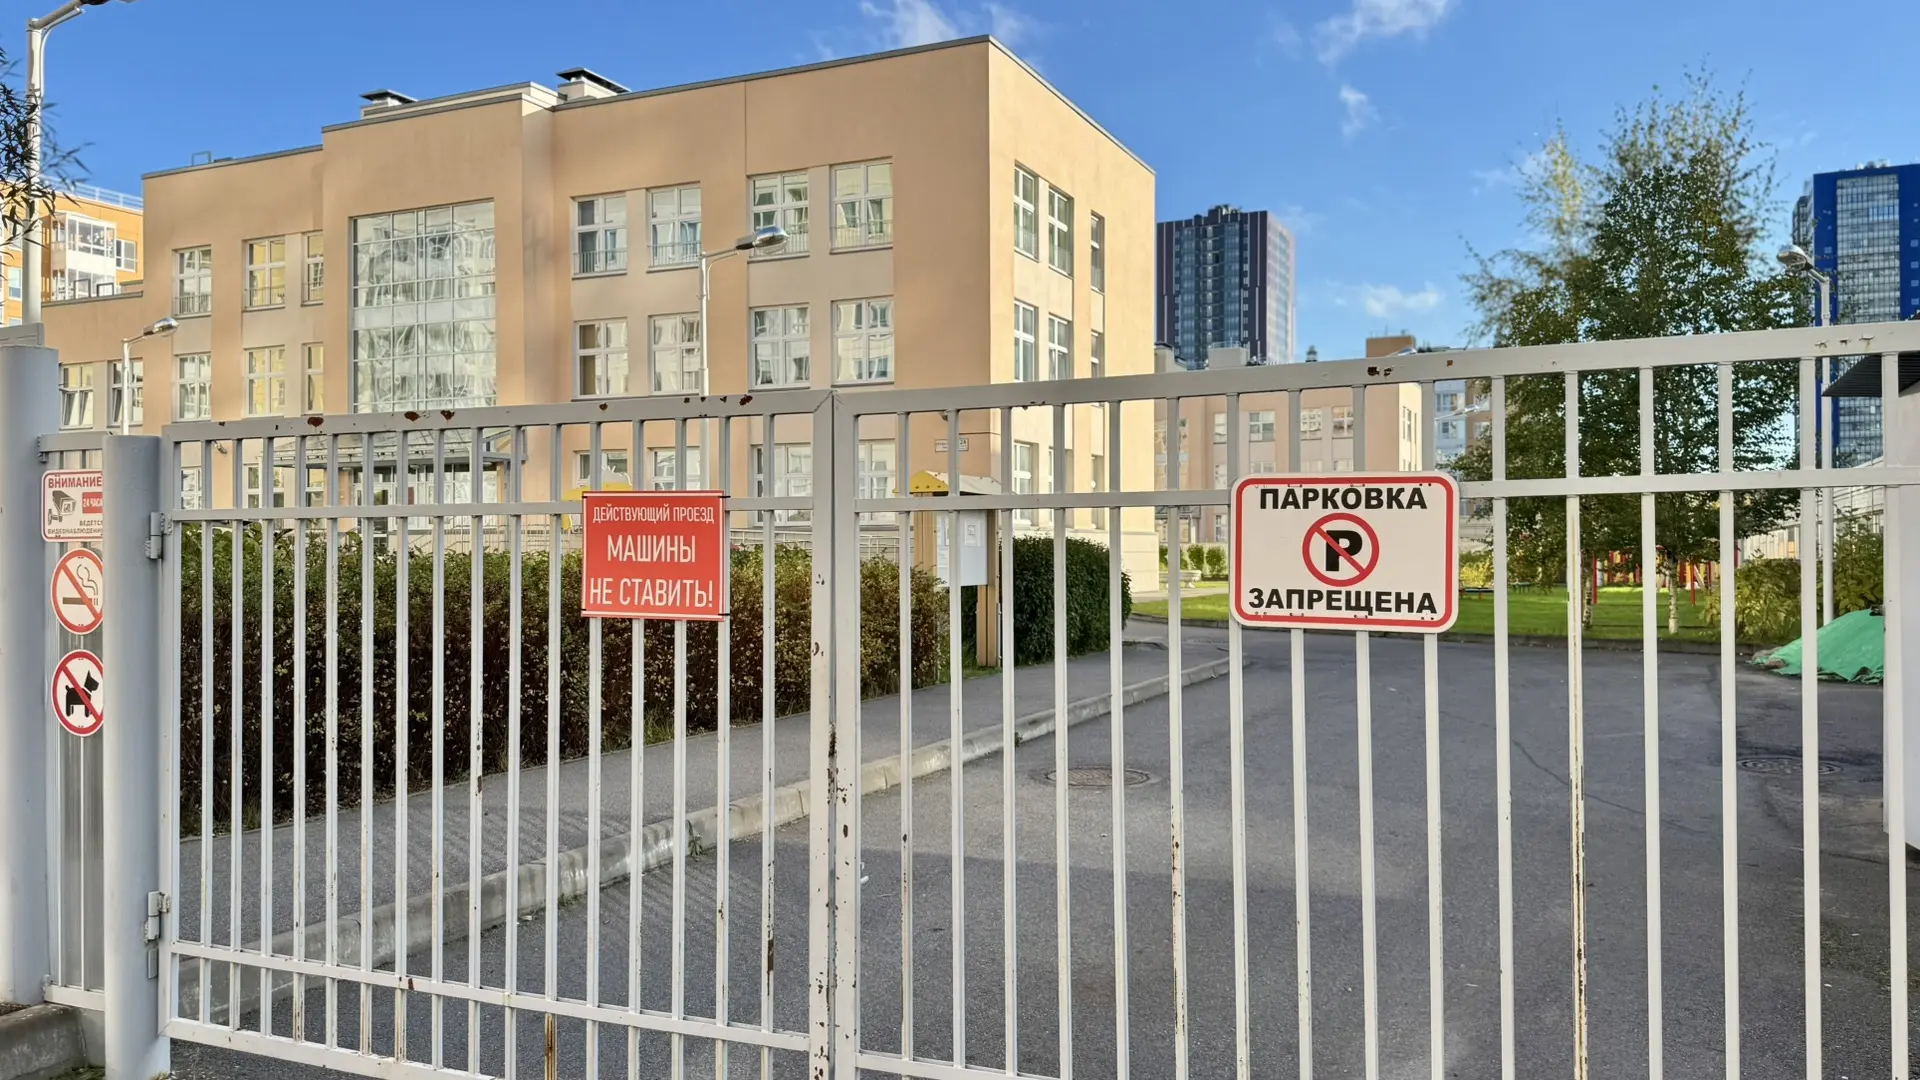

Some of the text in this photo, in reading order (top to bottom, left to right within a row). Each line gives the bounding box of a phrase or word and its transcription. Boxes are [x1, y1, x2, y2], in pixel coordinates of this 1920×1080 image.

[48, 476, 102, 488] ВНИМАНИЕ
[1260, 487, 1428, 510] ПАРКОВКА
[593, 504, 715, 524] ДЕЙСТВУЮЩИЙ ПРОЕЗД
[607, 535, 696, 562] МАШИНЫ
[589, 577, 713, 608] НЕ СТАВИТЬ!
[1249, 588, 1438, 616] ЗАПРЕЩЕНА
